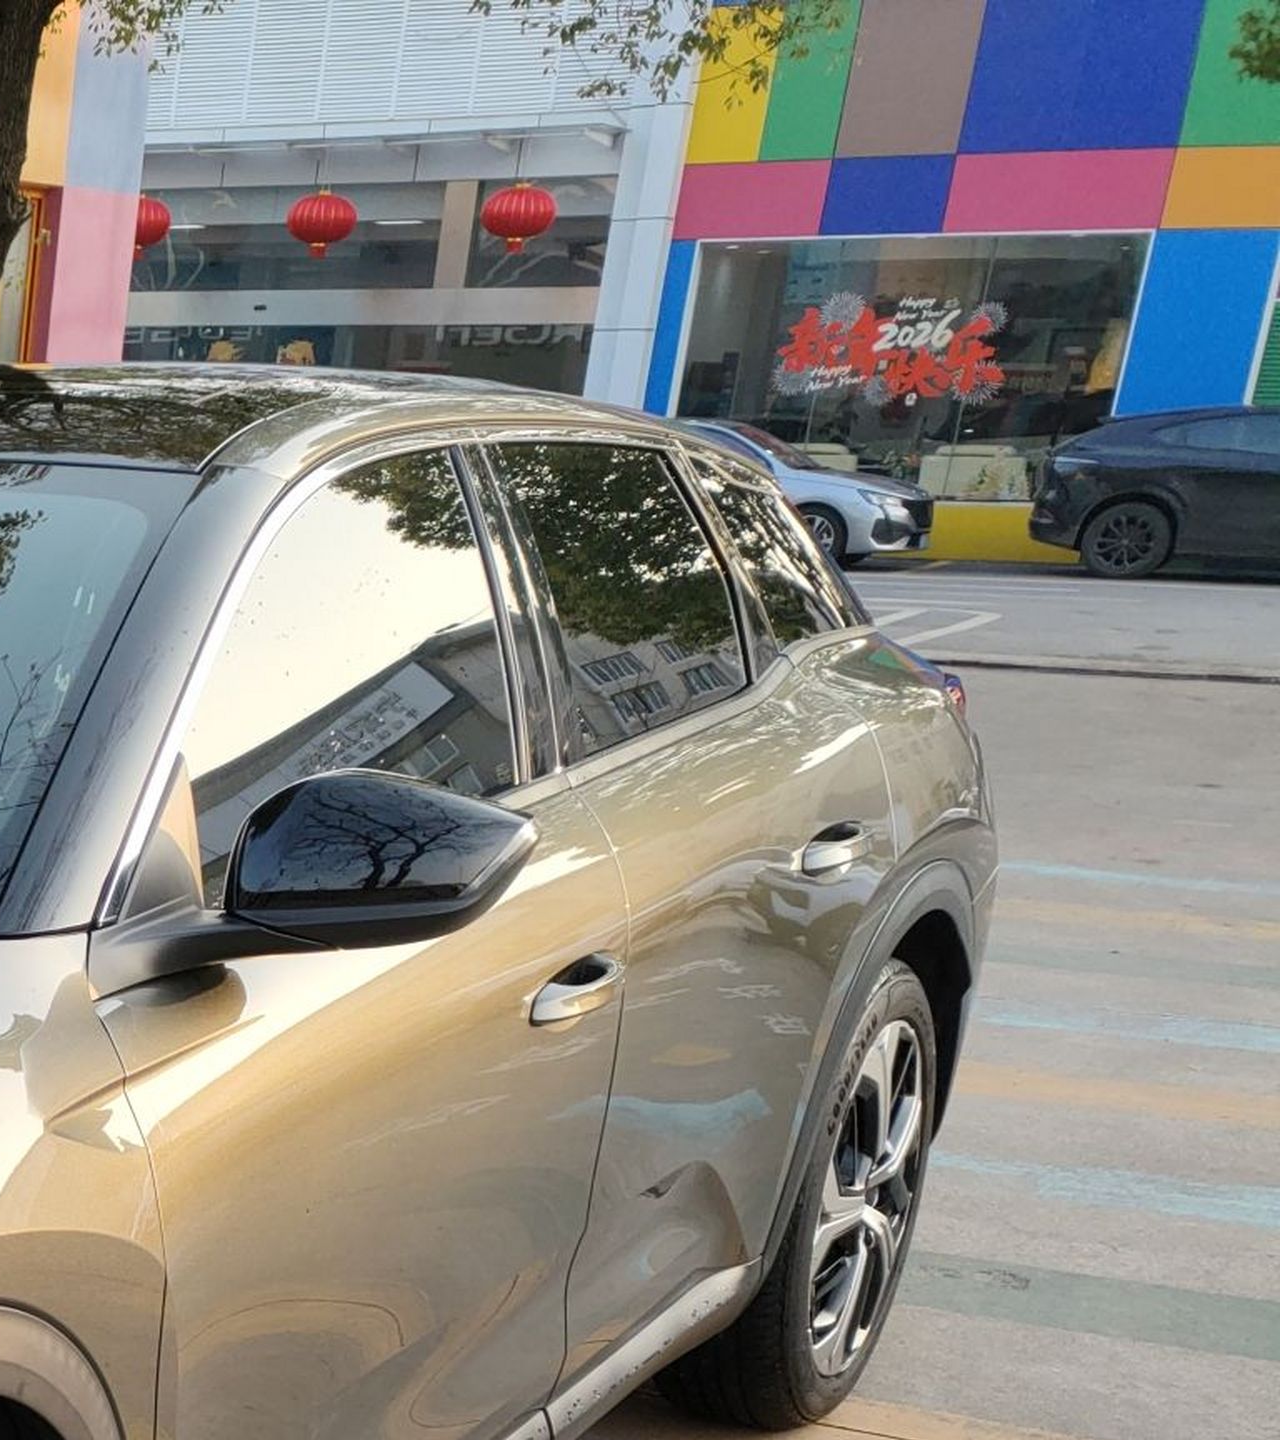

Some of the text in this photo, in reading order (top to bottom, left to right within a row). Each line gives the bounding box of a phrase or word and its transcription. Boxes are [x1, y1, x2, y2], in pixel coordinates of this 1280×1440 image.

[898, 296, 937, 310] Happy
[892, 311, 919, 322] New
[872, 309, 961, 352] 2026
[811, 365, 852, 379] Happy
[805, 379, 834, 394] New
